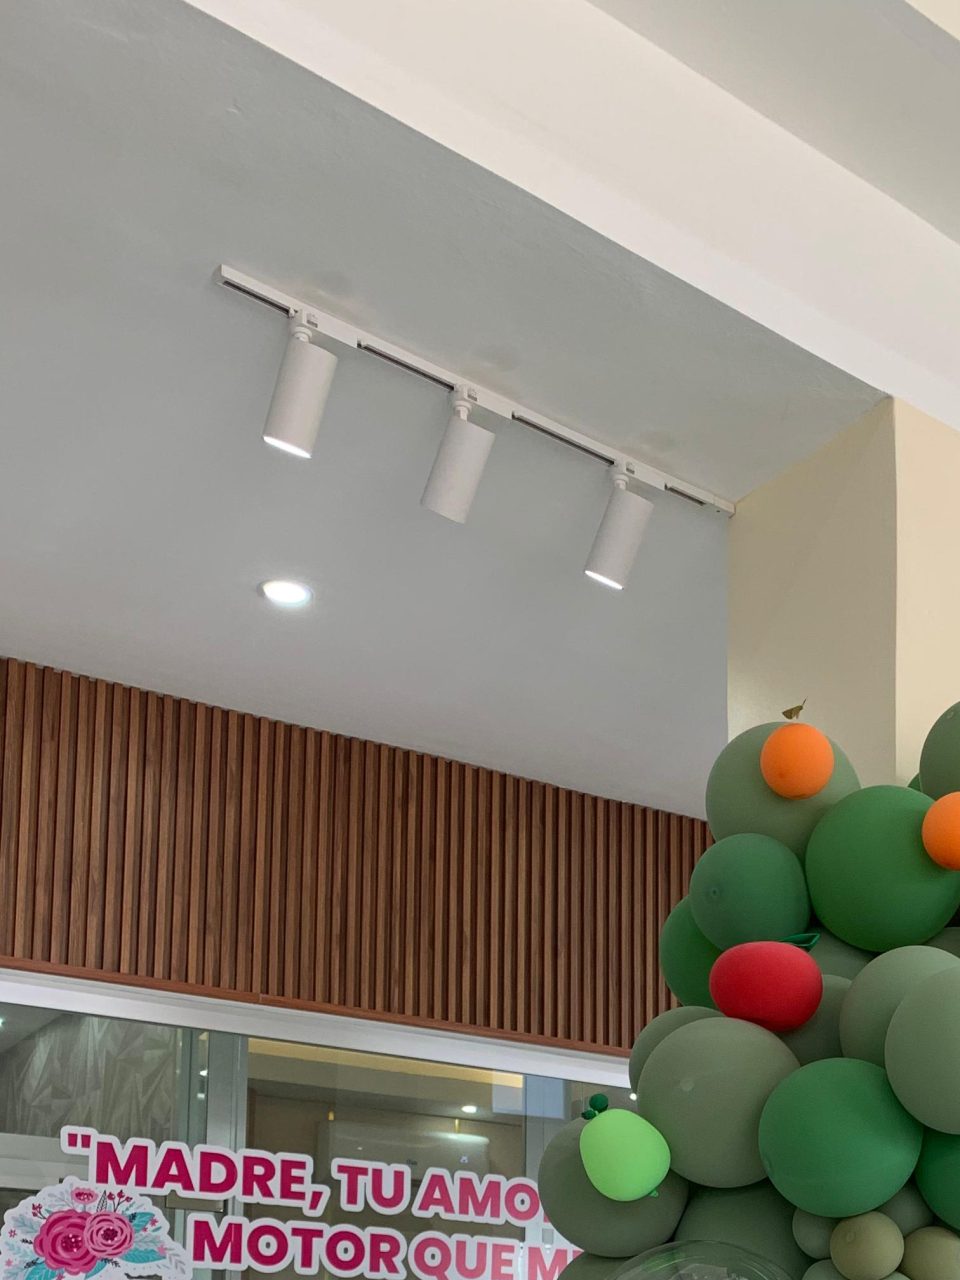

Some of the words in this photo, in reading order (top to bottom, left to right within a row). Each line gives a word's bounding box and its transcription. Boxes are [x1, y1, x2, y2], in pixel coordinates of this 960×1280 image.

[68, 1133, 323, 1210] "MADRE,
[337, 1165, 405, 1208] TU
[418, 1174, 549, 1223] AMO
[193, 1220, 399, 1275] MOTOR
